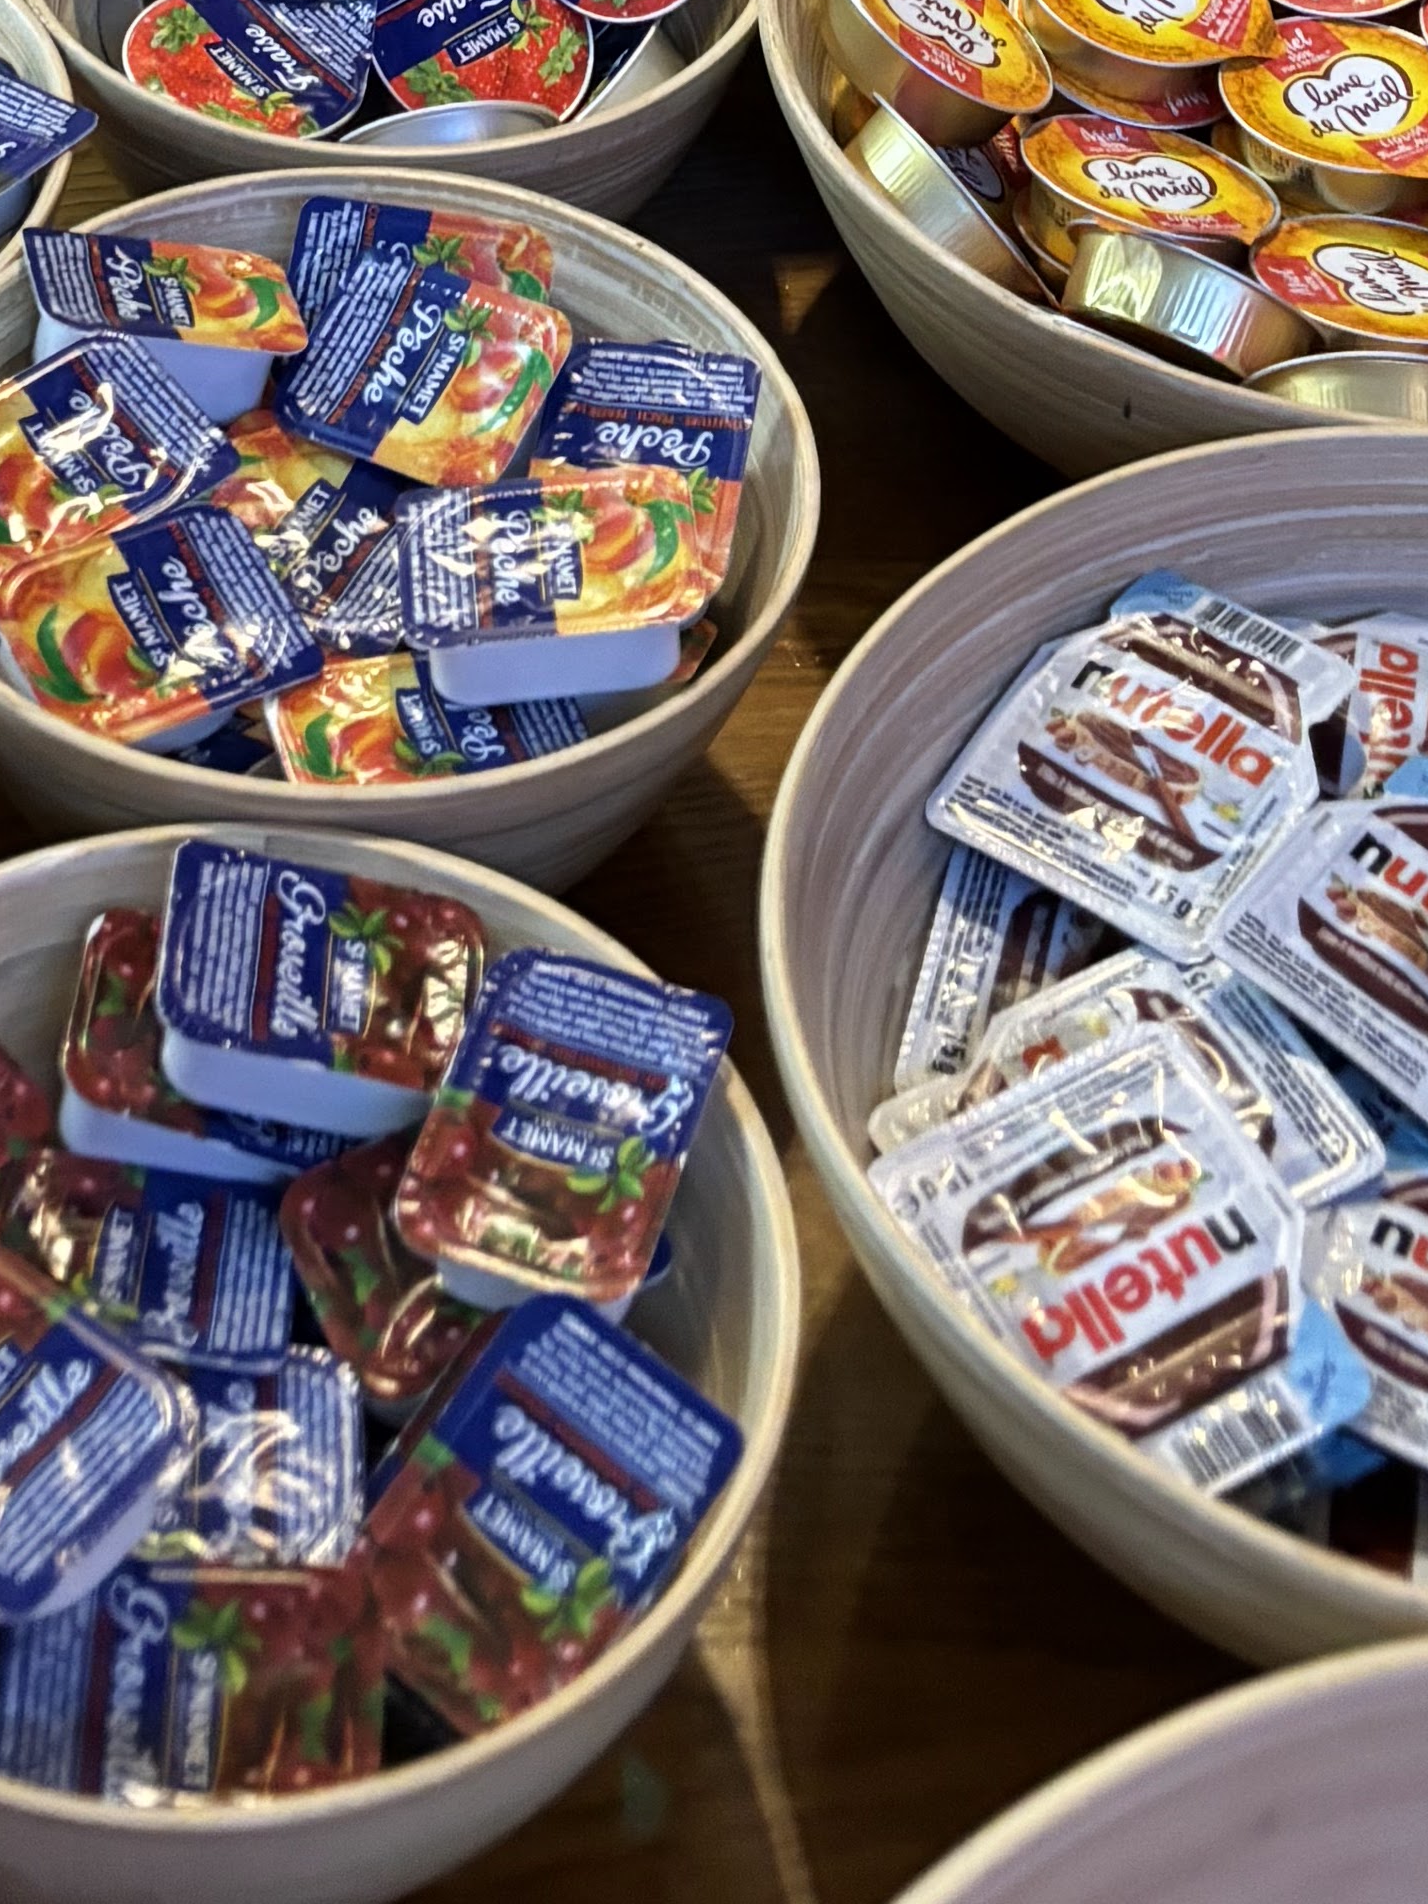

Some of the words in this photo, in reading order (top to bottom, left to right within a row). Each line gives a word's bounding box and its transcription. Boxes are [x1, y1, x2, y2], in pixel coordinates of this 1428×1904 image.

[458, 23, 507, 64] MAMET
[1131, 9, 1165, 35] de
[245, 24, 319, 90] Fraise
[1303, 74, 1376, 112] lune
[1310, 121, 1343, 138] de
[1335, 74, 1422, 136] Miel
[1130, 176, 1218, 202] Miel
[363, 297, 444, 404] Pêche
[413, 348, 462, 419] MAMET
[596, 421, 713, 466] Pêche
[113, 582, 162, 654] MAMET
[1070, 659, 1274, 787] nutella
[498, 1043, 695, 1137] Groseille
[502, 1115, 581, 1166] MAMET
[1020, 1204, 1258, 1370] nutella
